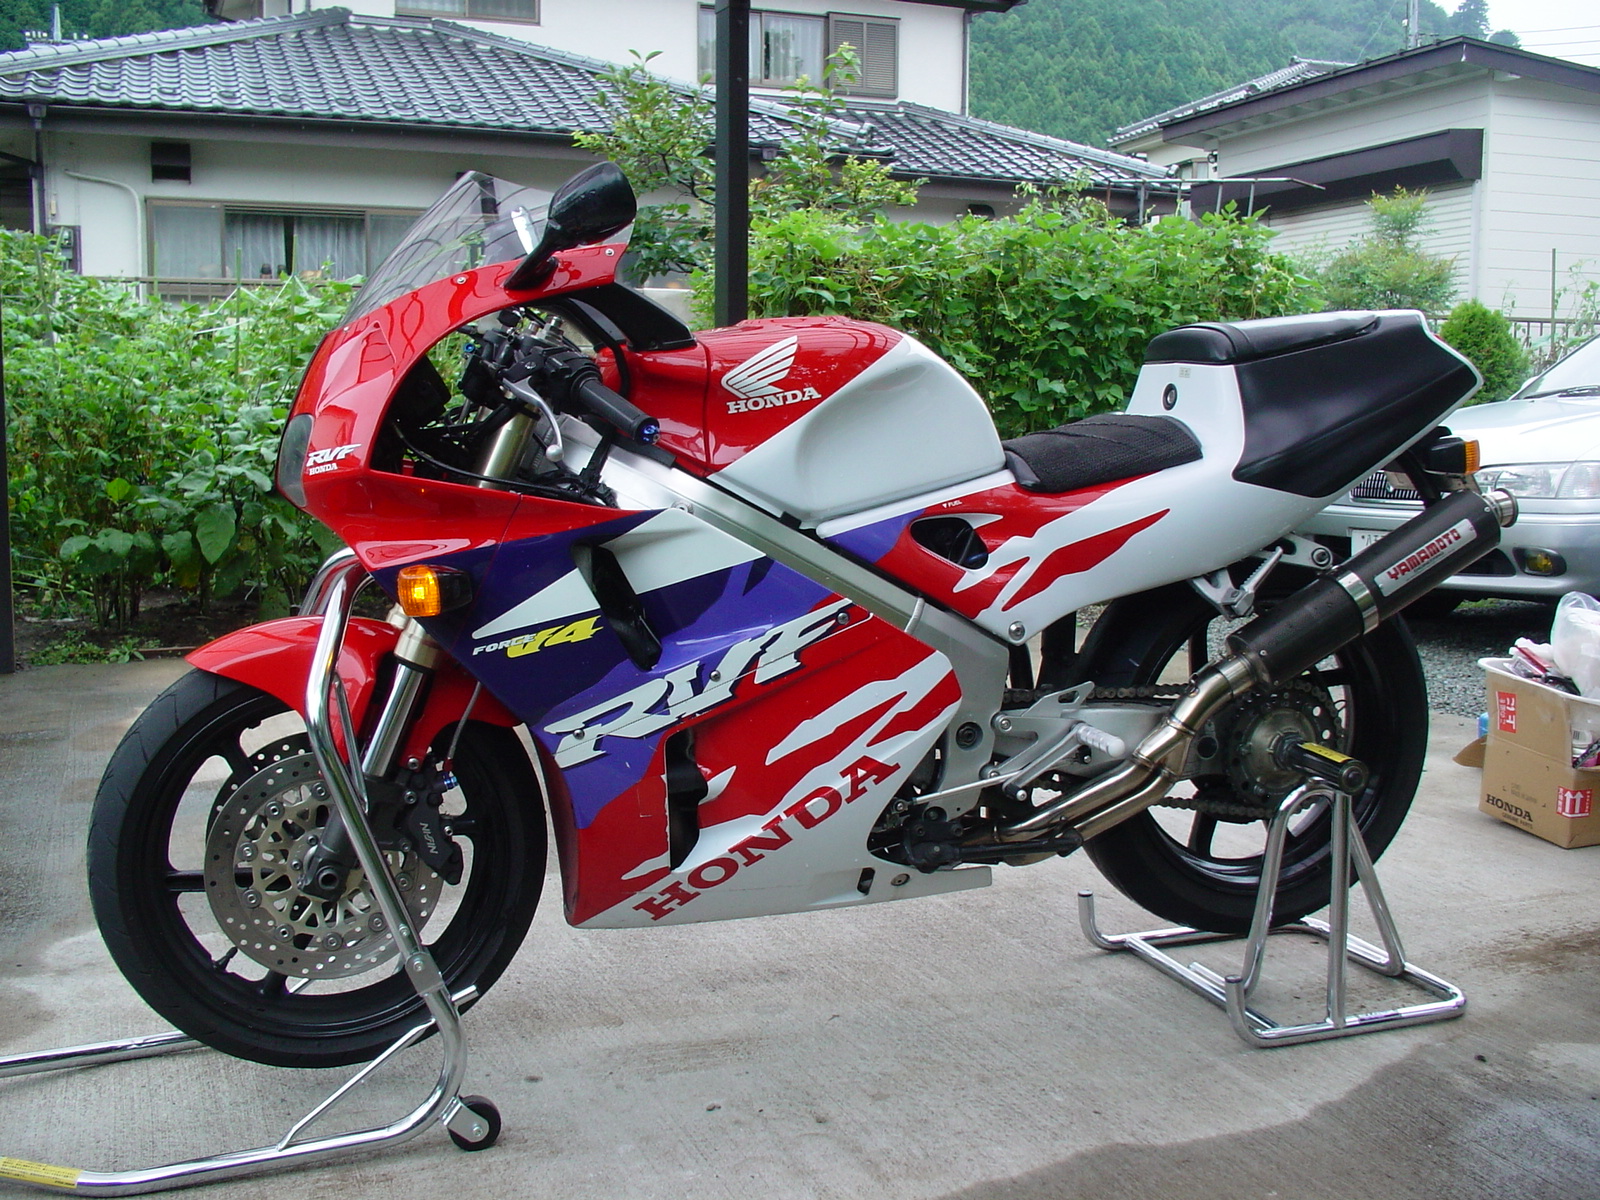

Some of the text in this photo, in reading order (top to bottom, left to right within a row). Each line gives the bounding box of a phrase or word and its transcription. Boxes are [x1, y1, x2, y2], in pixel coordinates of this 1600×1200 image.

[726, 386, 822, 414] HONDA
[306, 443, 362, 467] RVF
[309, 463, 338, 476] HONDA
[1386, 528, 1462, 580] YAMAMOTO
[472, 633, 536, 655] FORCE
[543, 597, 853, 769] RVF
[1486, 793, 1534, 823] HONDA
[632, 755, 901, 921] HONDA
